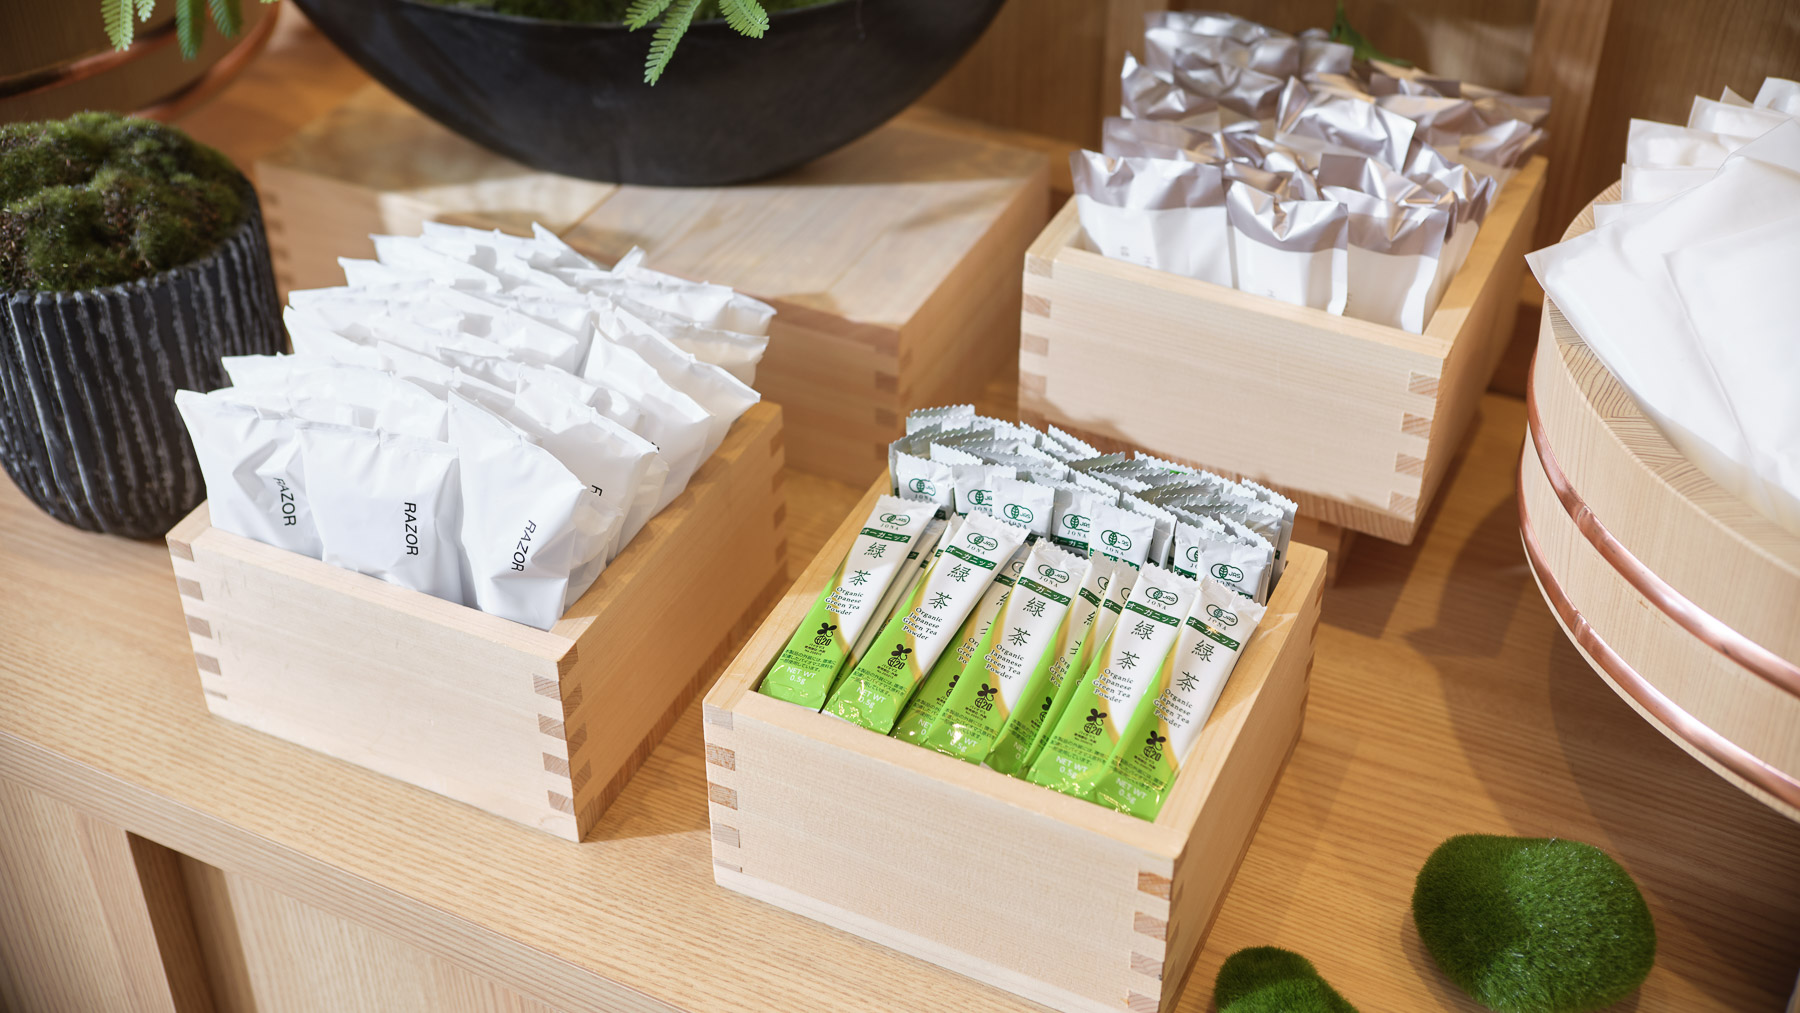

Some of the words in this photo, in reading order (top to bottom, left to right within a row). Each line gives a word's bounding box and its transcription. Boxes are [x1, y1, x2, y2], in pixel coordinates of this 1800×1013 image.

[403, 501, 419, 556] RAZOR
[861, 528, 909, 542] オーガニック
[881, 523, 899, 531] JONA
[1067, 530, 1087, 539] JONA
[511, 519, 537, 572] RAZOR
[966, 544, 985, 555] JONA
[1105, 546, 1124, 556] JONA
[946, 546, 994, 568] オーガニック
[1039, 576, 1058, 588] JONA
[831, 592, 862, 604] Japanese
[836, 587, 864, 597] Organic
[1019, 578, 1069, 604] オーガニック
[825, 597, 846, 608] Green
[825, 604, 852, 616] Powder
[1146, 599, 1167, 610] JONA
[909, 612, 940, 629] Japanese
[915, 607, 943, 622] Organic
[1126, 602, 1177, 625] オーガニック
[902, 617, 923, 632] Green
[926, 628, 938, 636] Tea
[1207, 617, 1227, 631] JONA
[902, 625, 929, 641] Powder
[1187, 618, 1237, 648] オーガニック
[990, 649, 1022, 668] Japanese
[996, 644, 1024, 661] Organic
[786, 666, 801, 675] NET
[803, 670, 816, 678] WT
[984, 654, 1006, 670] Green
[1008, 666, 1021, 676] Tea
[985, 663, 1013, 680] Powder
[789, 675, 806, 685] 0.5g
[1099, 674, 1132, 691] Japanese
[1104, 668, 1134, 684] Organic
[1093, 679, 1115, 694] Green
[1117, 690, 1131, 699] Tea
[1094, 688, 1122, 704] Powder
[873, 693, 887, 704] WT
[1159, 694, 1191, 716] Japanese
[1164, 688, 1193, 709] Organic
[1153, 699, 1175, 717] Green
[1176, 714, 1190, 724] Tea
[1154, 709, 1181, 729] Powder
[964, 737, 978, 748] WT
[1056, 755, 1073, 767] NET
[1074, 762, 1088, 773] WT
[1116, 778, 1132, 790] NET
[1133, 787, 1148, 799] WT
